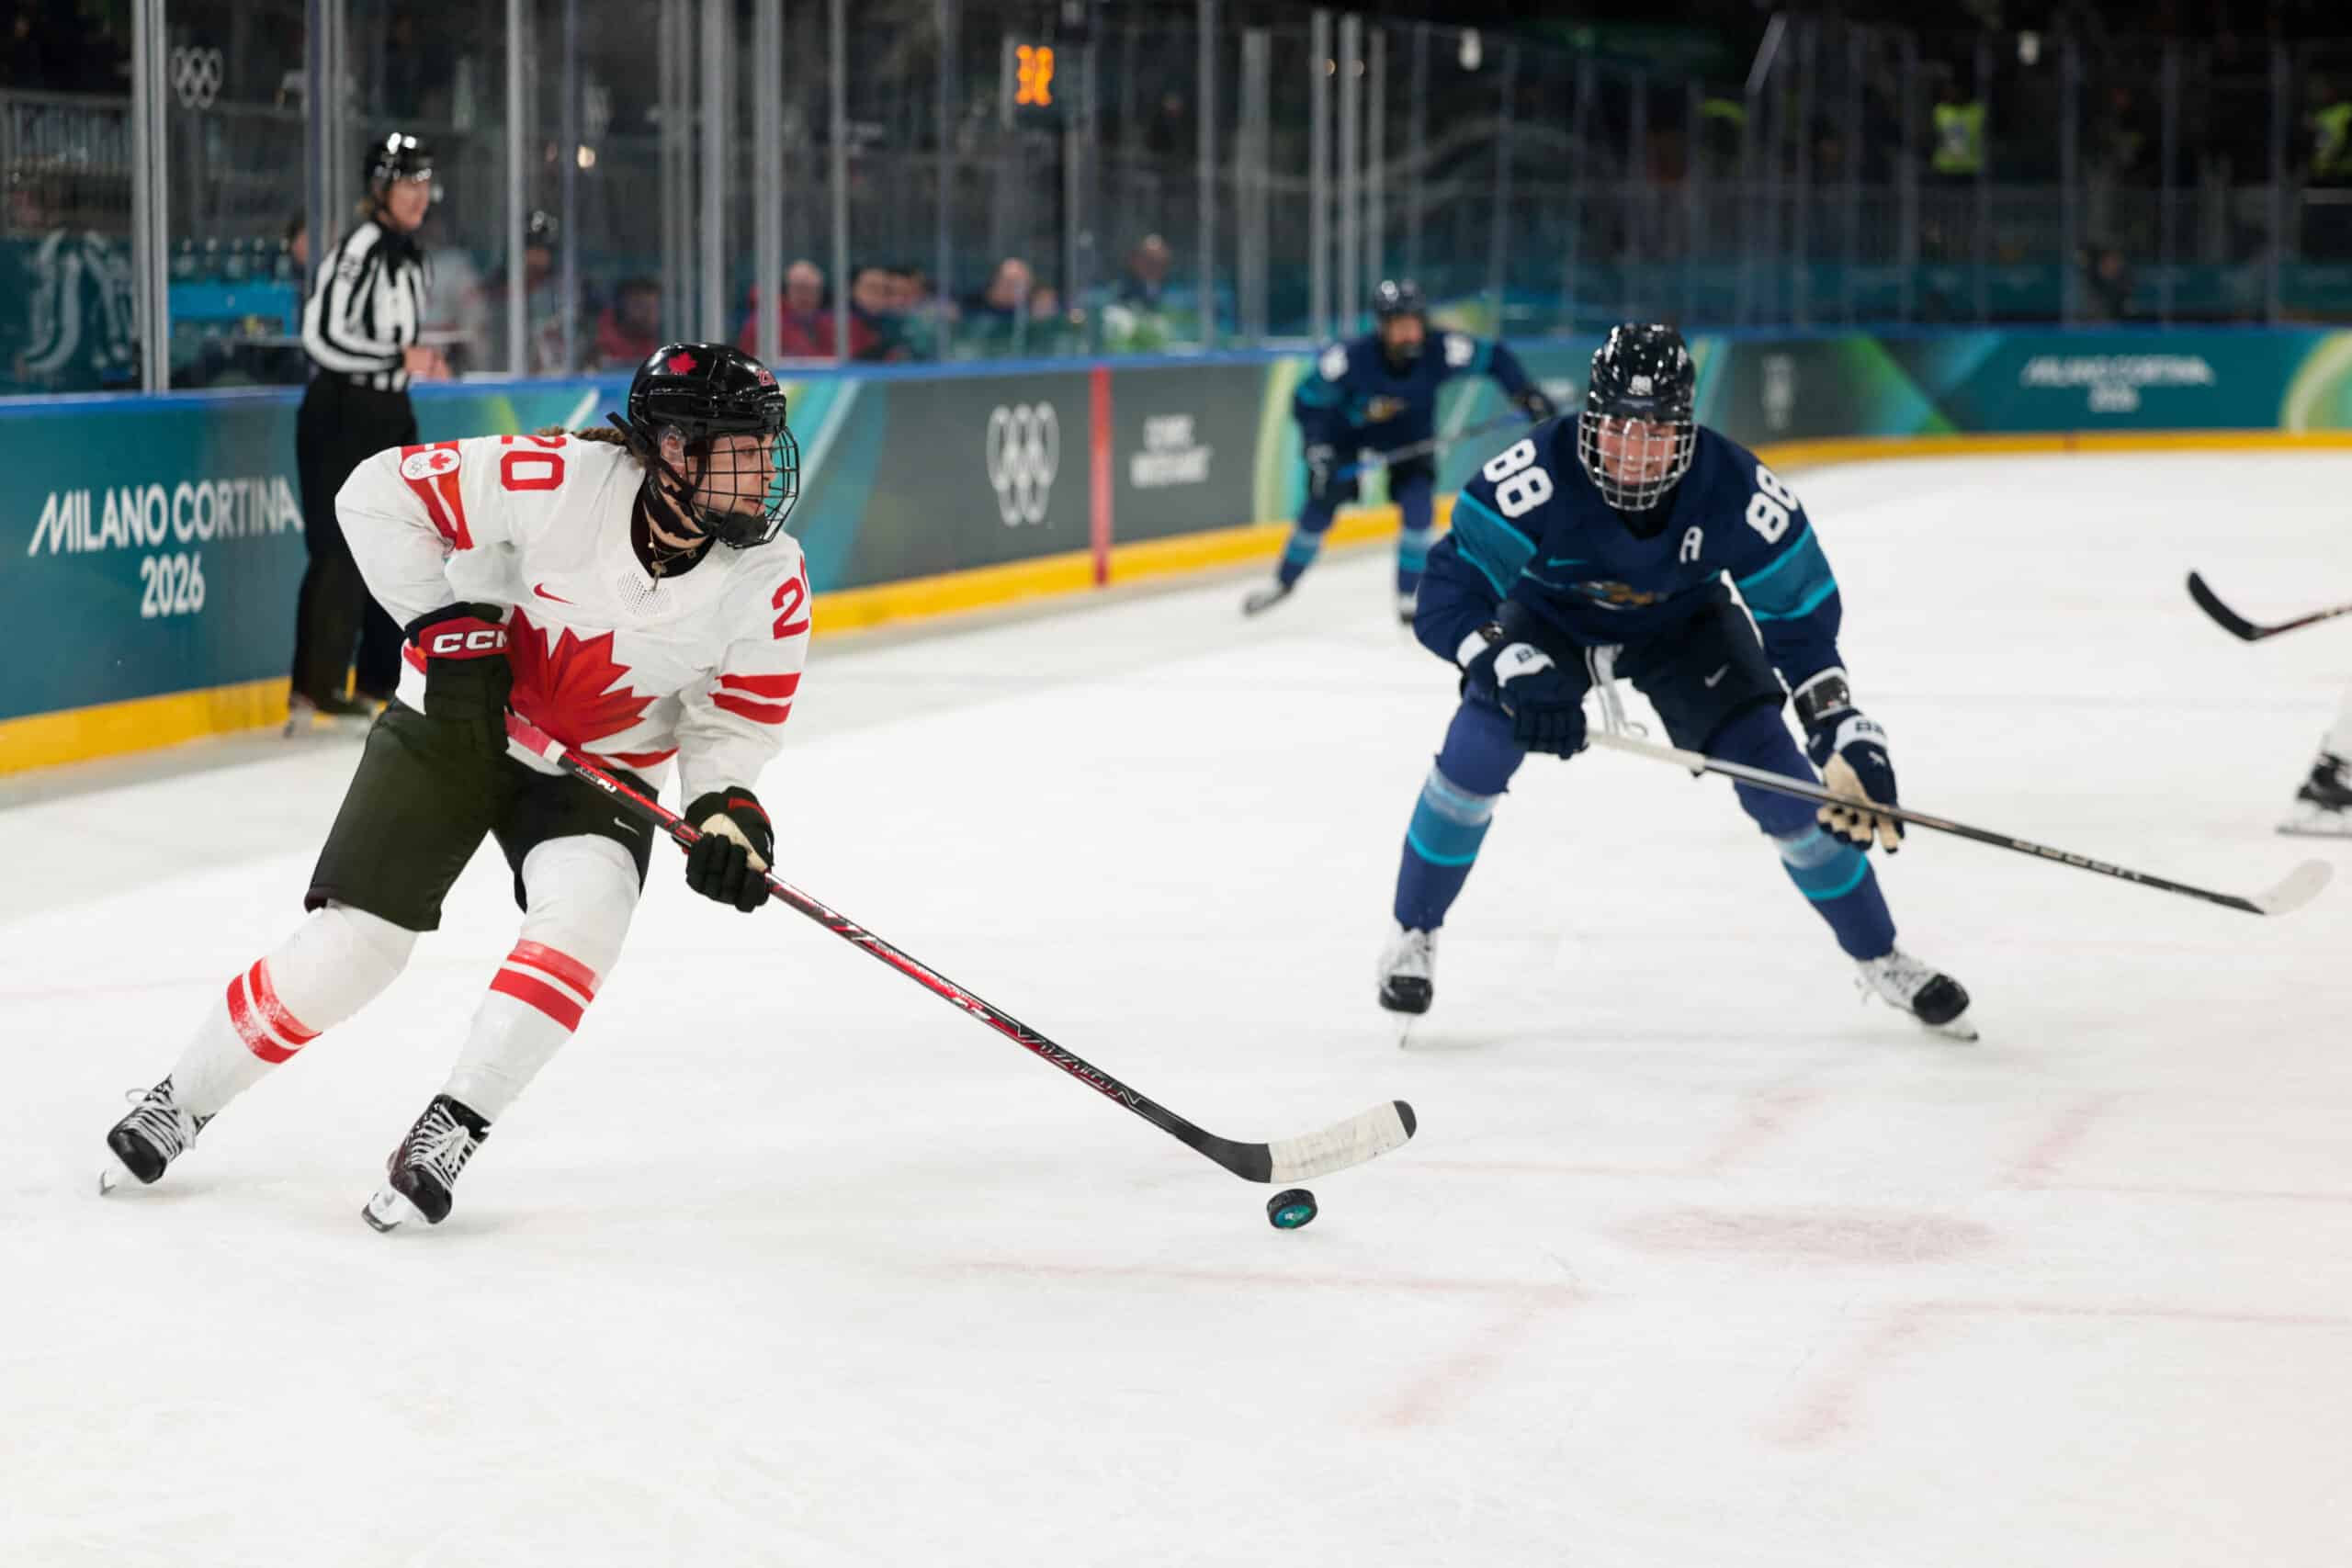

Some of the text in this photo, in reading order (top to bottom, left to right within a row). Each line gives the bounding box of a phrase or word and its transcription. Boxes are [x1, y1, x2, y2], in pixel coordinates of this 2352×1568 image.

[28, 474, 305, 557] MILANO CORTINA
[1482, 438, 1555, 518] 88
[1745, 464, 1799, 545] 88
[1679, 525, 1704, 564] A
[140, 552, 206, 618] 2026
[771, 554, 812, 640] 2
